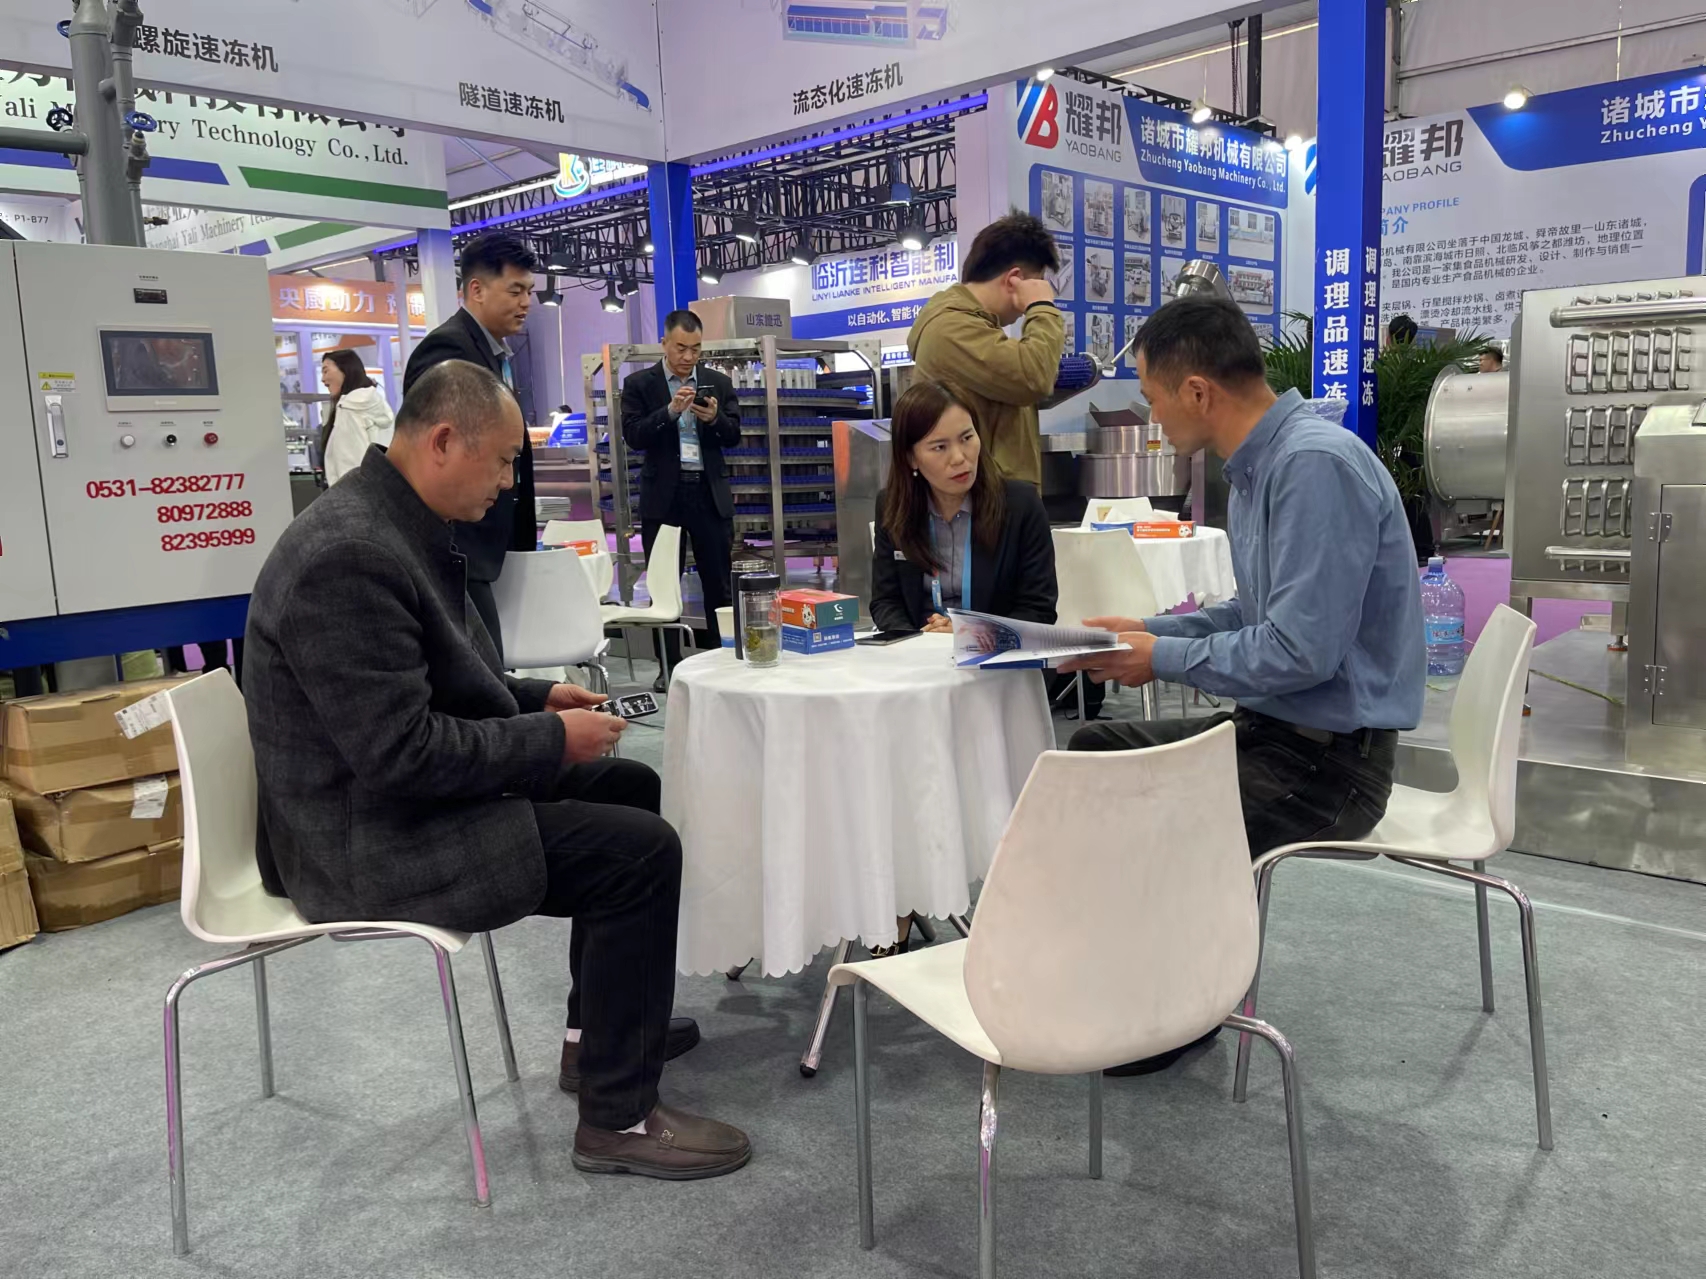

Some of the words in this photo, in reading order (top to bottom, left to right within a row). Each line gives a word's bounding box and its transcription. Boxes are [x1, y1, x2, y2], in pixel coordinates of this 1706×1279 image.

[133, 25, 279, 73] 螺旋速冻机
[459, 81, 564, 123] 隧道速冻机
[793, 62, 903, 115] 流态化速冻机
[1601, 85, 1706, 126] 诸城市
[0, 94, 37, 119] ali
[192, 118, 317, 156] Technology
[1065, 91, 1121, 146] 耀邦
[1600, 121, 1693, 144] Zhucheng
[1065, 138, 1122, 163] YAOBANG
[1140, 148, 1182, 173] Zhucheng
[1183, 158, 1217, 181] Yaobang
[1218, 167, 1256, 189] Machinery
[1382, 161, 1462, 182] AOBANG
[1412, 197, 1460, 212] PROFILE
[200, 215, 245, 241] Machinery
[811, 241, 955, 291] 临沂连科智能制
[811, 291, 832, 302] LINYI
[832, 287, 861, 299] LIANKE
[862, 280, 917, 295] INTELLIGENT
[1362, 246, 1377, 406] 调理品速冻
[157, 500, 253, 523] 80972888
[161, 527, 256, 551] 82395999
